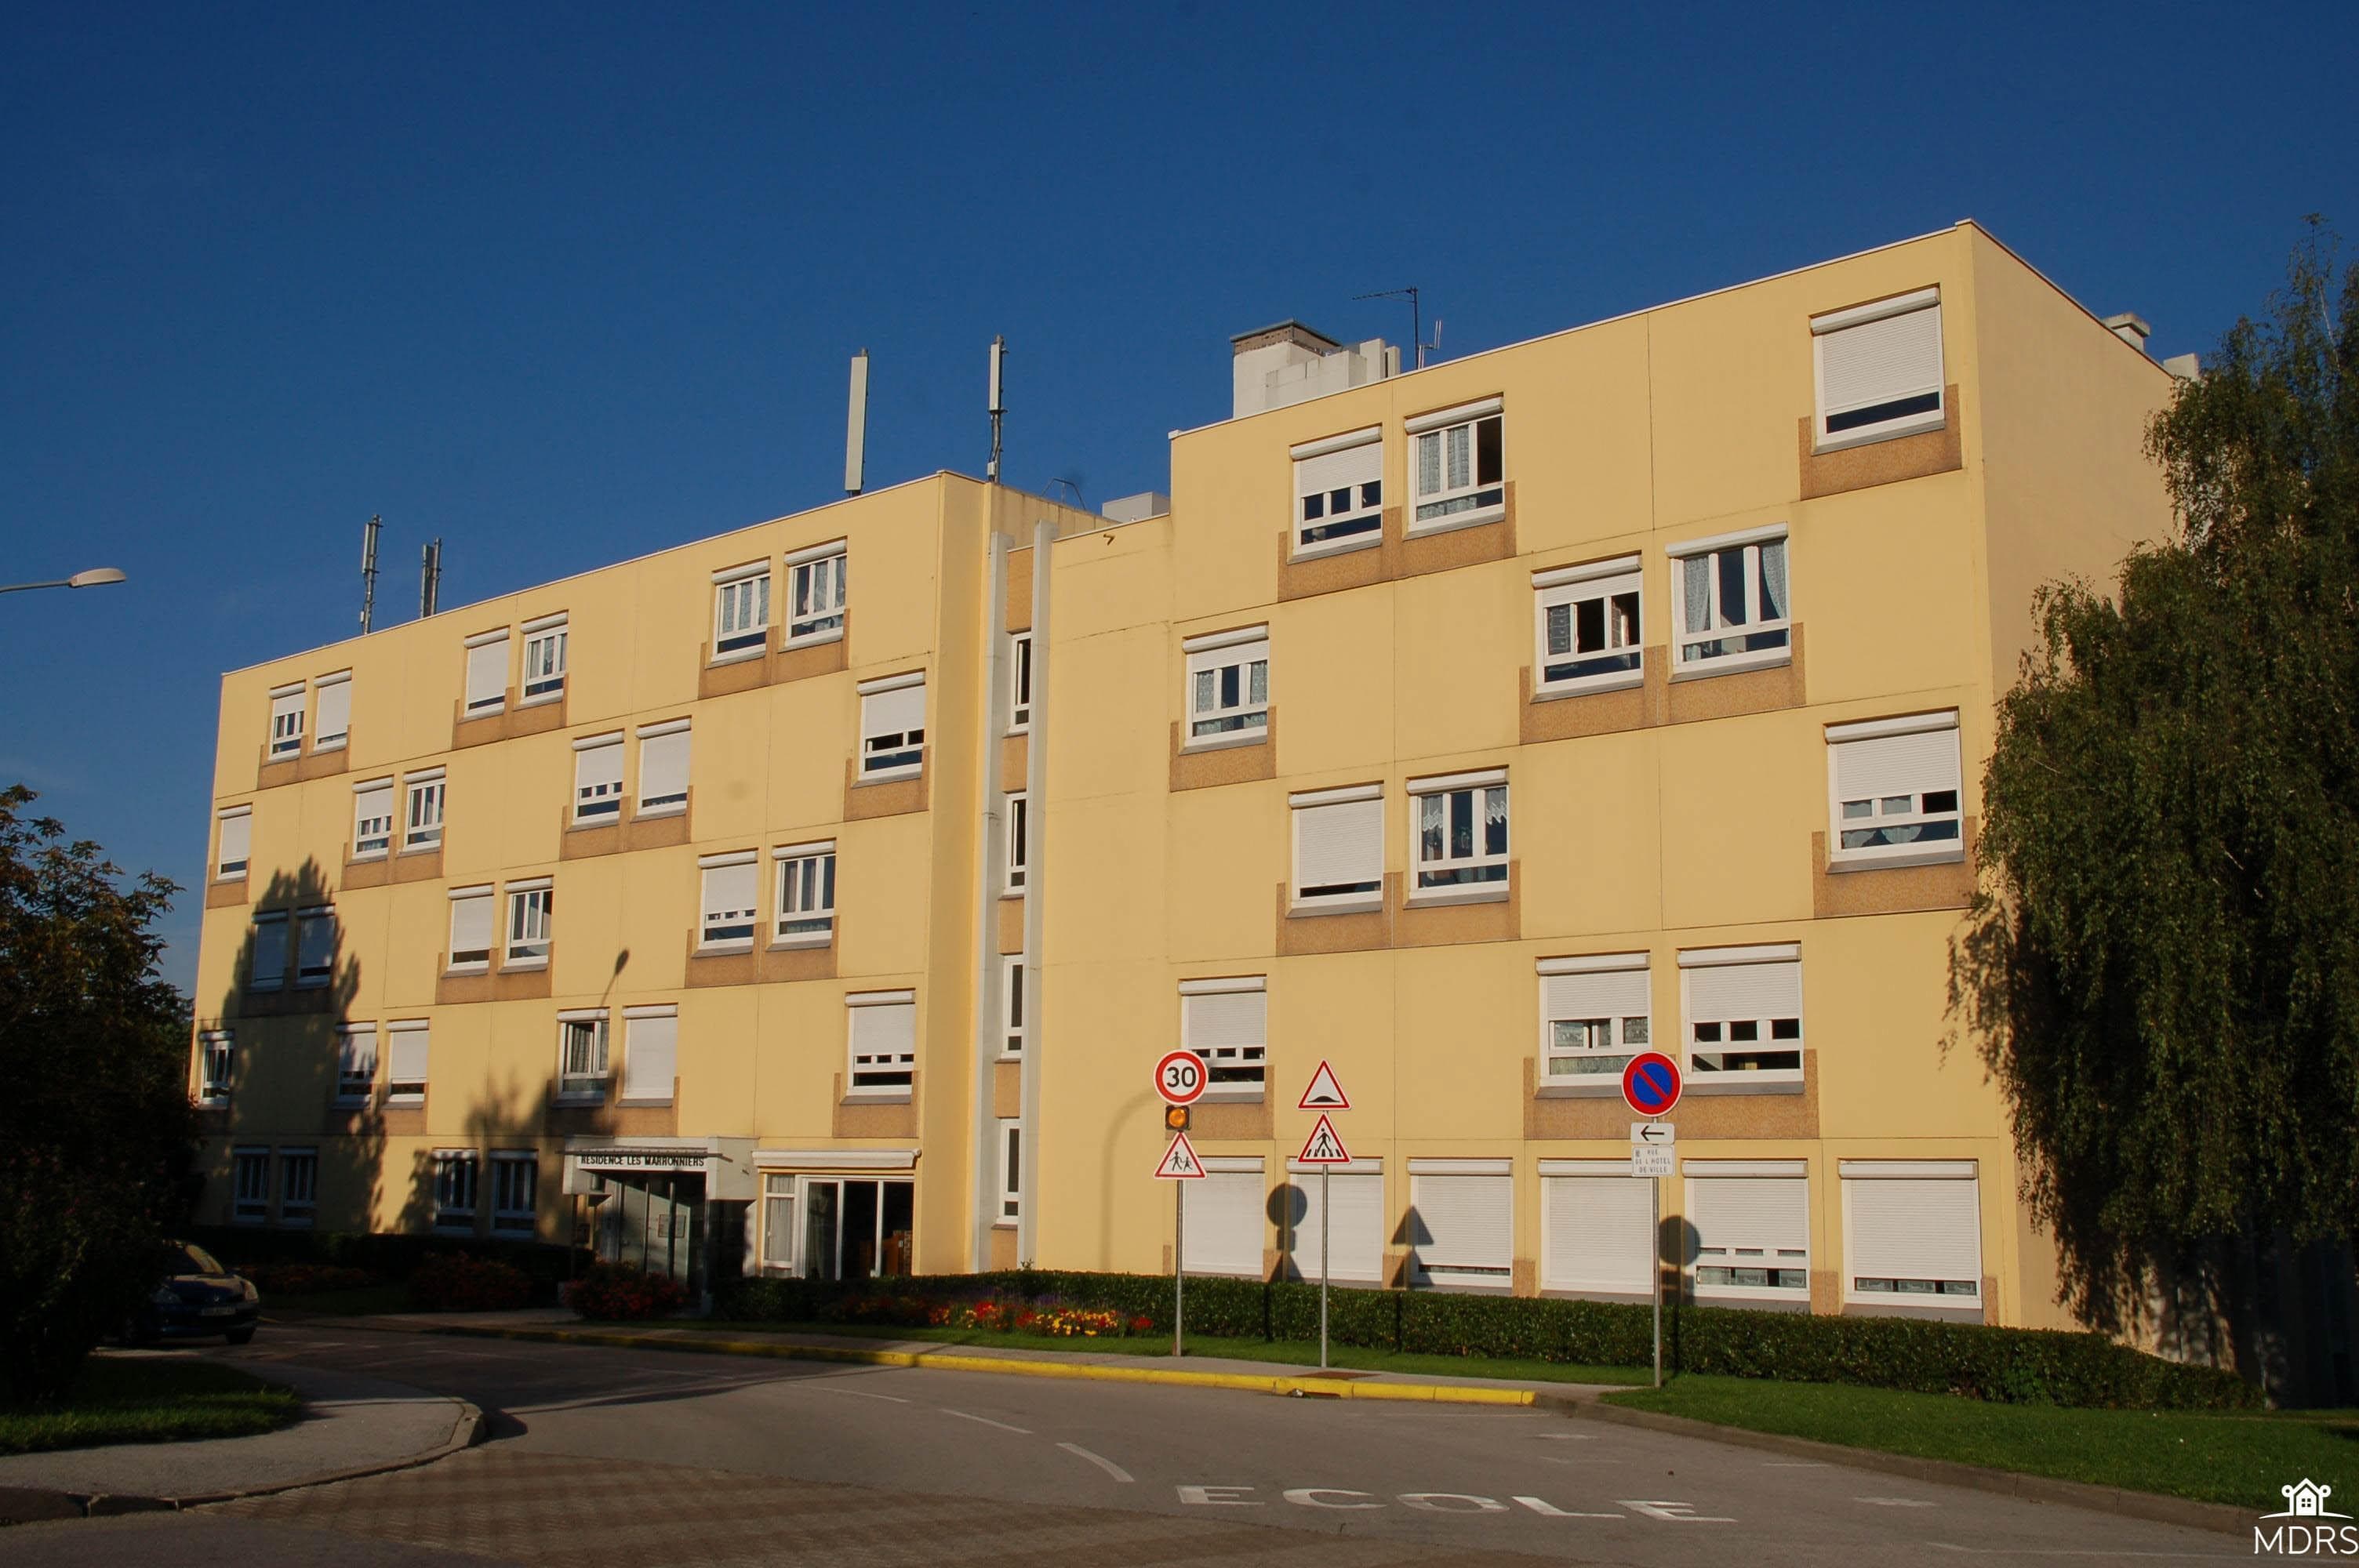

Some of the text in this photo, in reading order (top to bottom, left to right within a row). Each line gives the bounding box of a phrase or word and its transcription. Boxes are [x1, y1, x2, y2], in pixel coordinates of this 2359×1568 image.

[1167, 1066, 1197, 1087] 30
[627, 1155, 641, 1166] LES
[645, 1156, 704, 1167] MARRONNIERS
[1176, 1486, 1739, 1523] ECOLE
